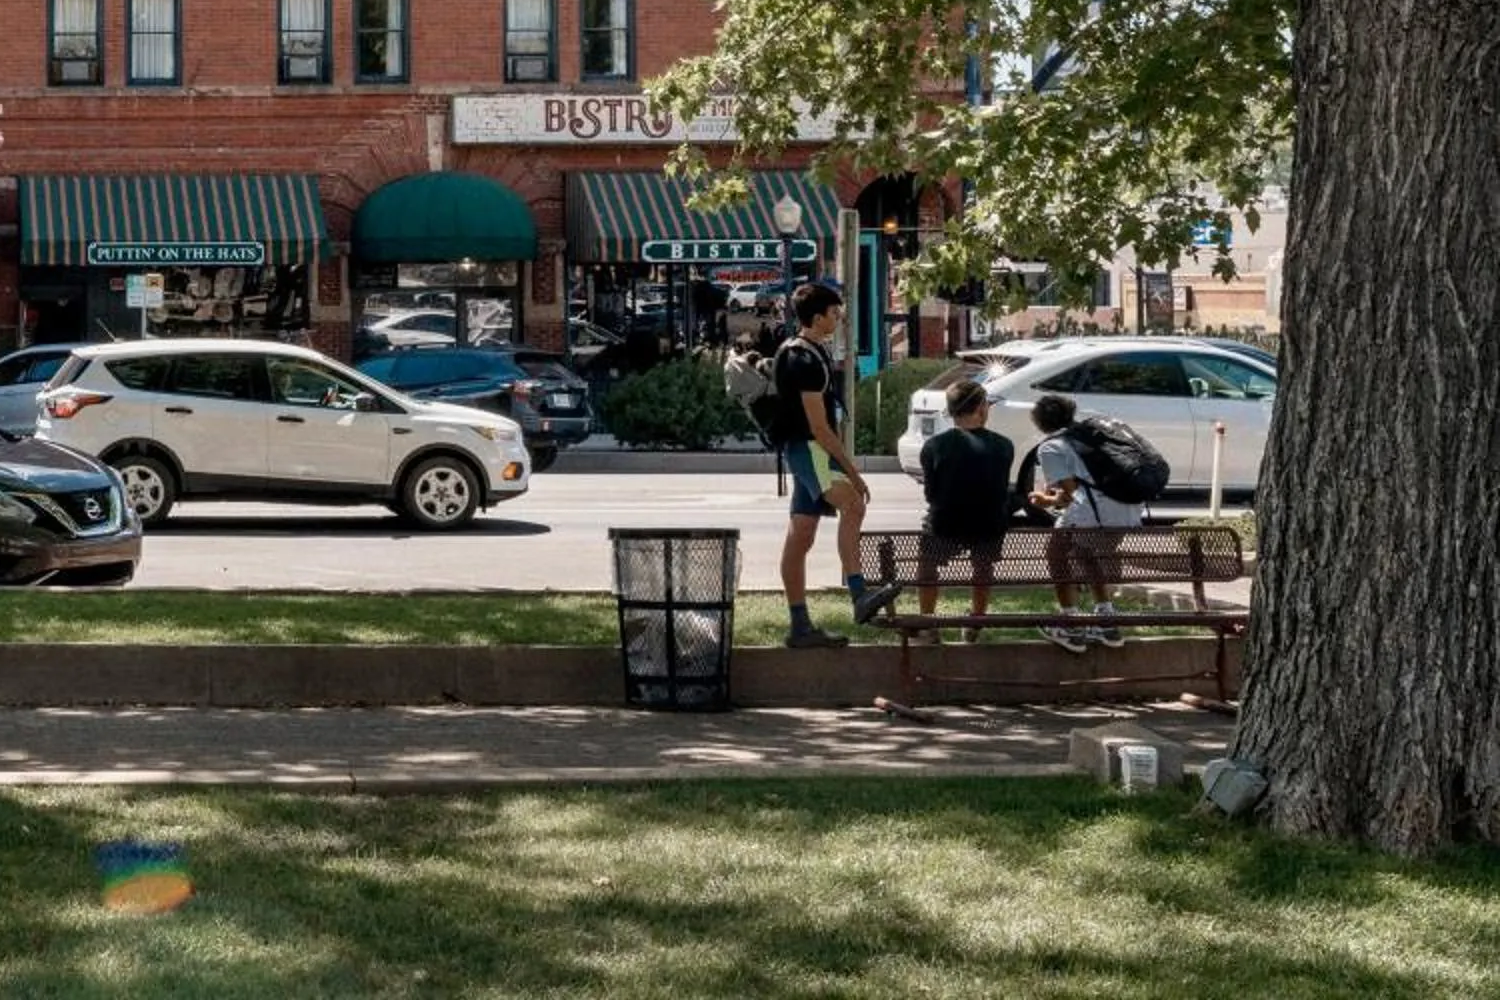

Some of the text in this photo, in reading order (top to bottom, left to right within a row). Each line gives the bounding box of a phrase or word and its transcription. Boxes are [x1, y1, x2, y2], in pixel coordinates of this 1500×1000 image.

[97, 247, 257, 260] PUTTIN' ON THE HATS
